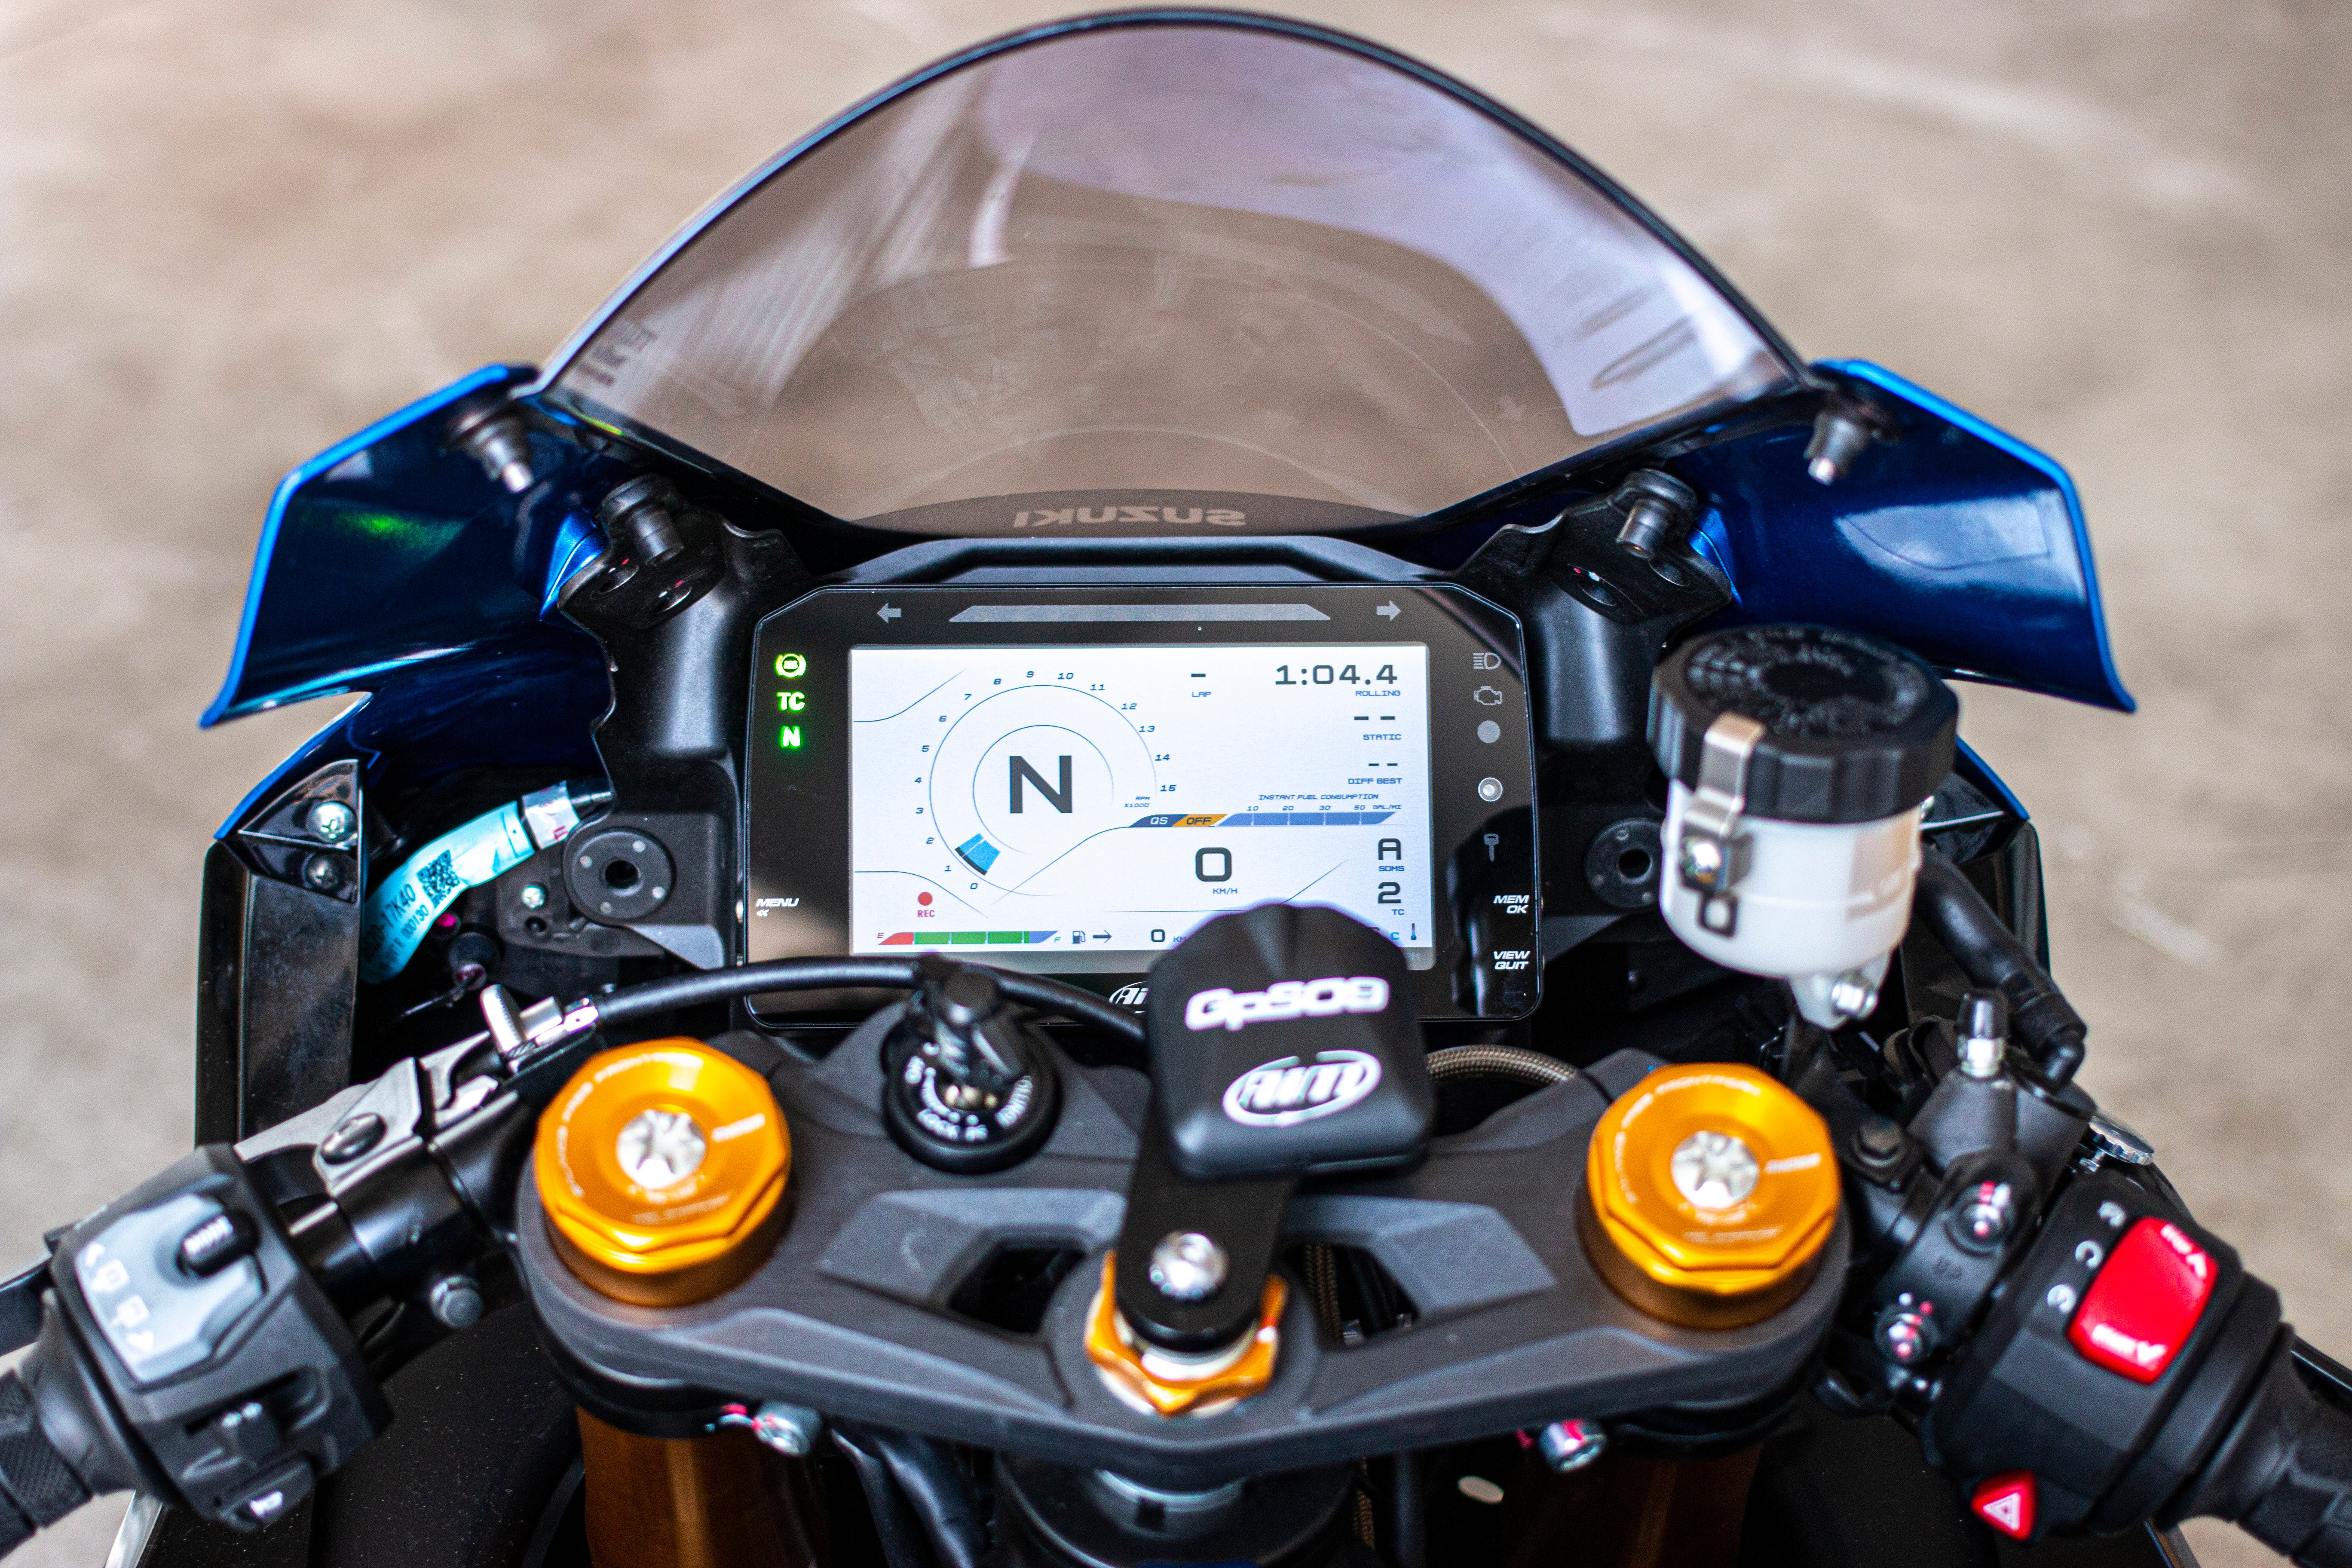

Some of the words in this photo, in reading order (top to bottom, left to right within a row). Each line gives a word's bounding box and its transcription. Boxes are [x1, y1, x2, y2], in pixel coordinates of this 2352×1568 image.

[1275, 664, 1398, 686] 1:04.4
[776, 692, 806, 711] TC
[781, 726, 801, 748] N
[921, 744, 930, 753] 5
[1009, 755, 1073, 814] N
[1160, 784, 1177, 792] 15
[1150, 817, 1168, 825] QS
[1378, 838, 1402, 861] A
[1377, 882, 1402, 904] 2
[755, 898, 799, 906] MENU
[1493, 895, 1530, 904] MEM
[917, 910, 935, 918] REC
[1506, 905, 1529, 914] OK
[1493, 951, 1531, 960] VIEW
[1494, 961, 1529, 970] QUIT
